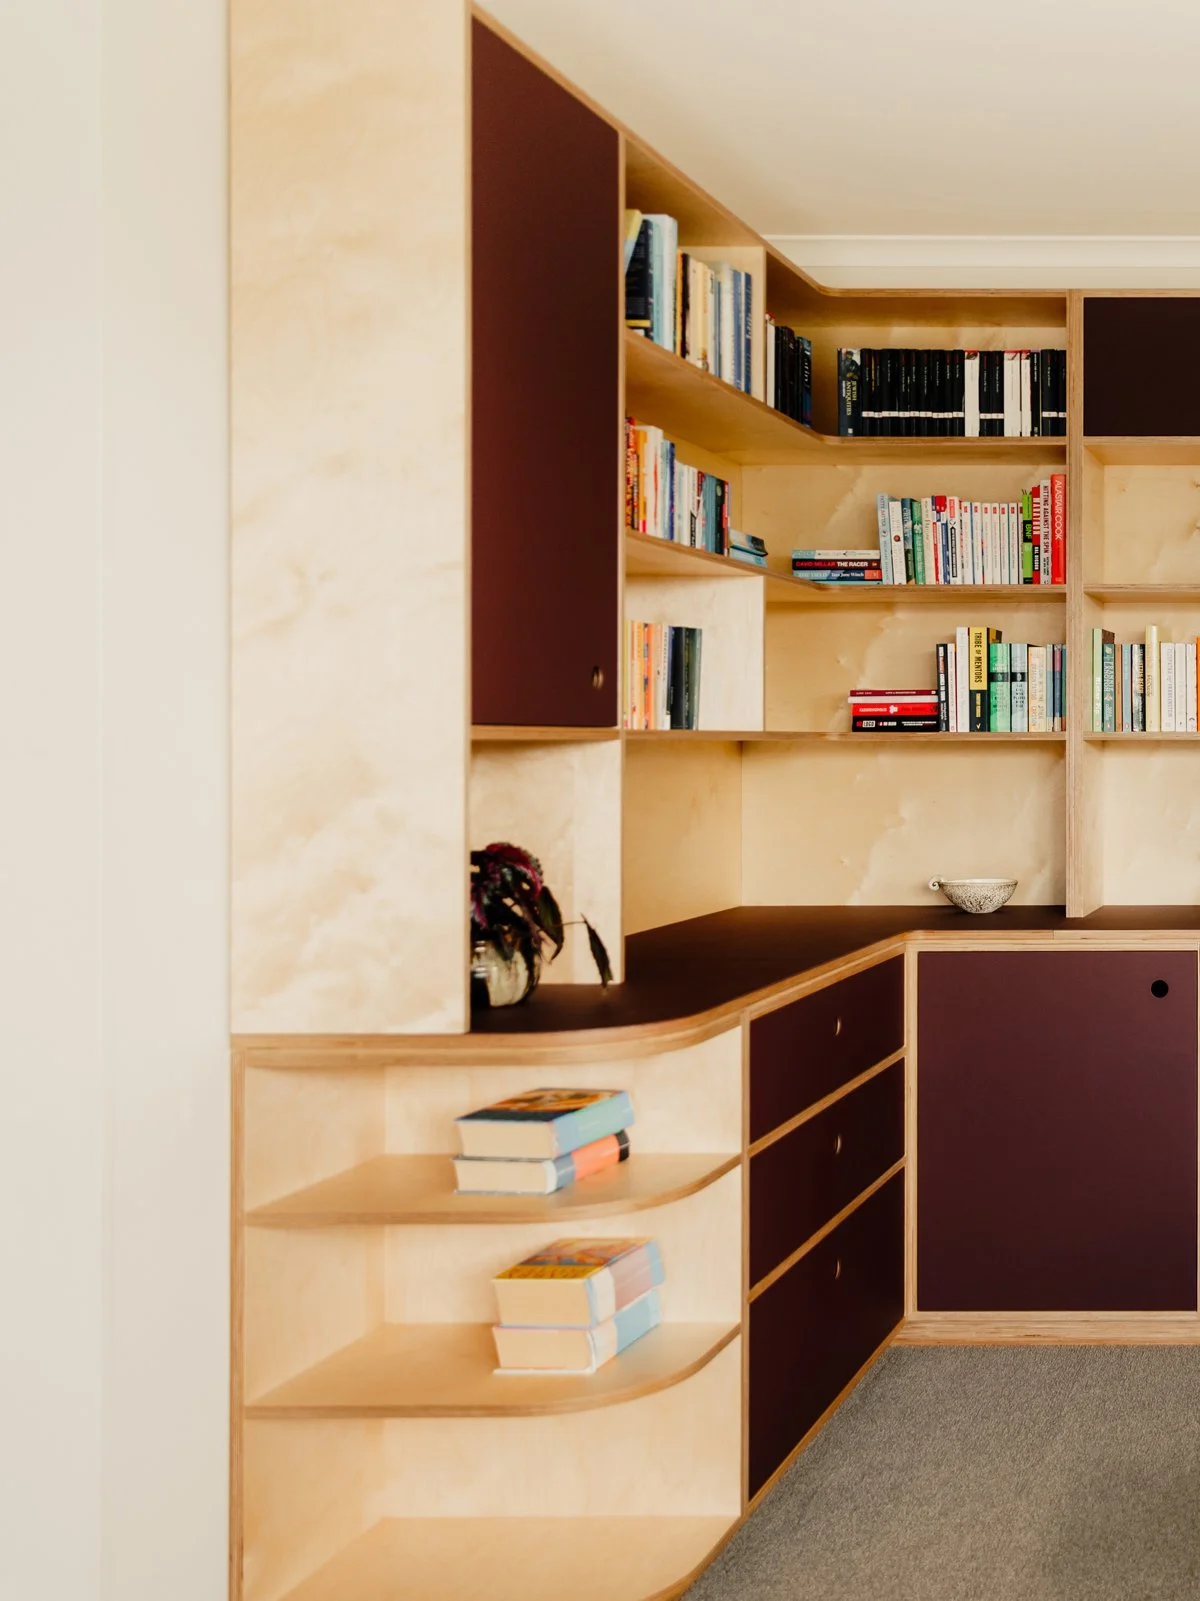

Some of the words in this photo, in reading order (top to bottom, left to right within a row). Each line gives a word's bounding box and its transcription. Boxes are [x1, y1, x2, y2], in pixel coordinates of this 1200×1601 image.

[1054, 480, 1062, 514] ALASTAIR
[1032, 497, 1040, 535] MARATHON
[1054, 514, 1062, 541] COOK
[974, 632, 982, 648] TRIBE
[974, 656, 982, 683] MENTORS
